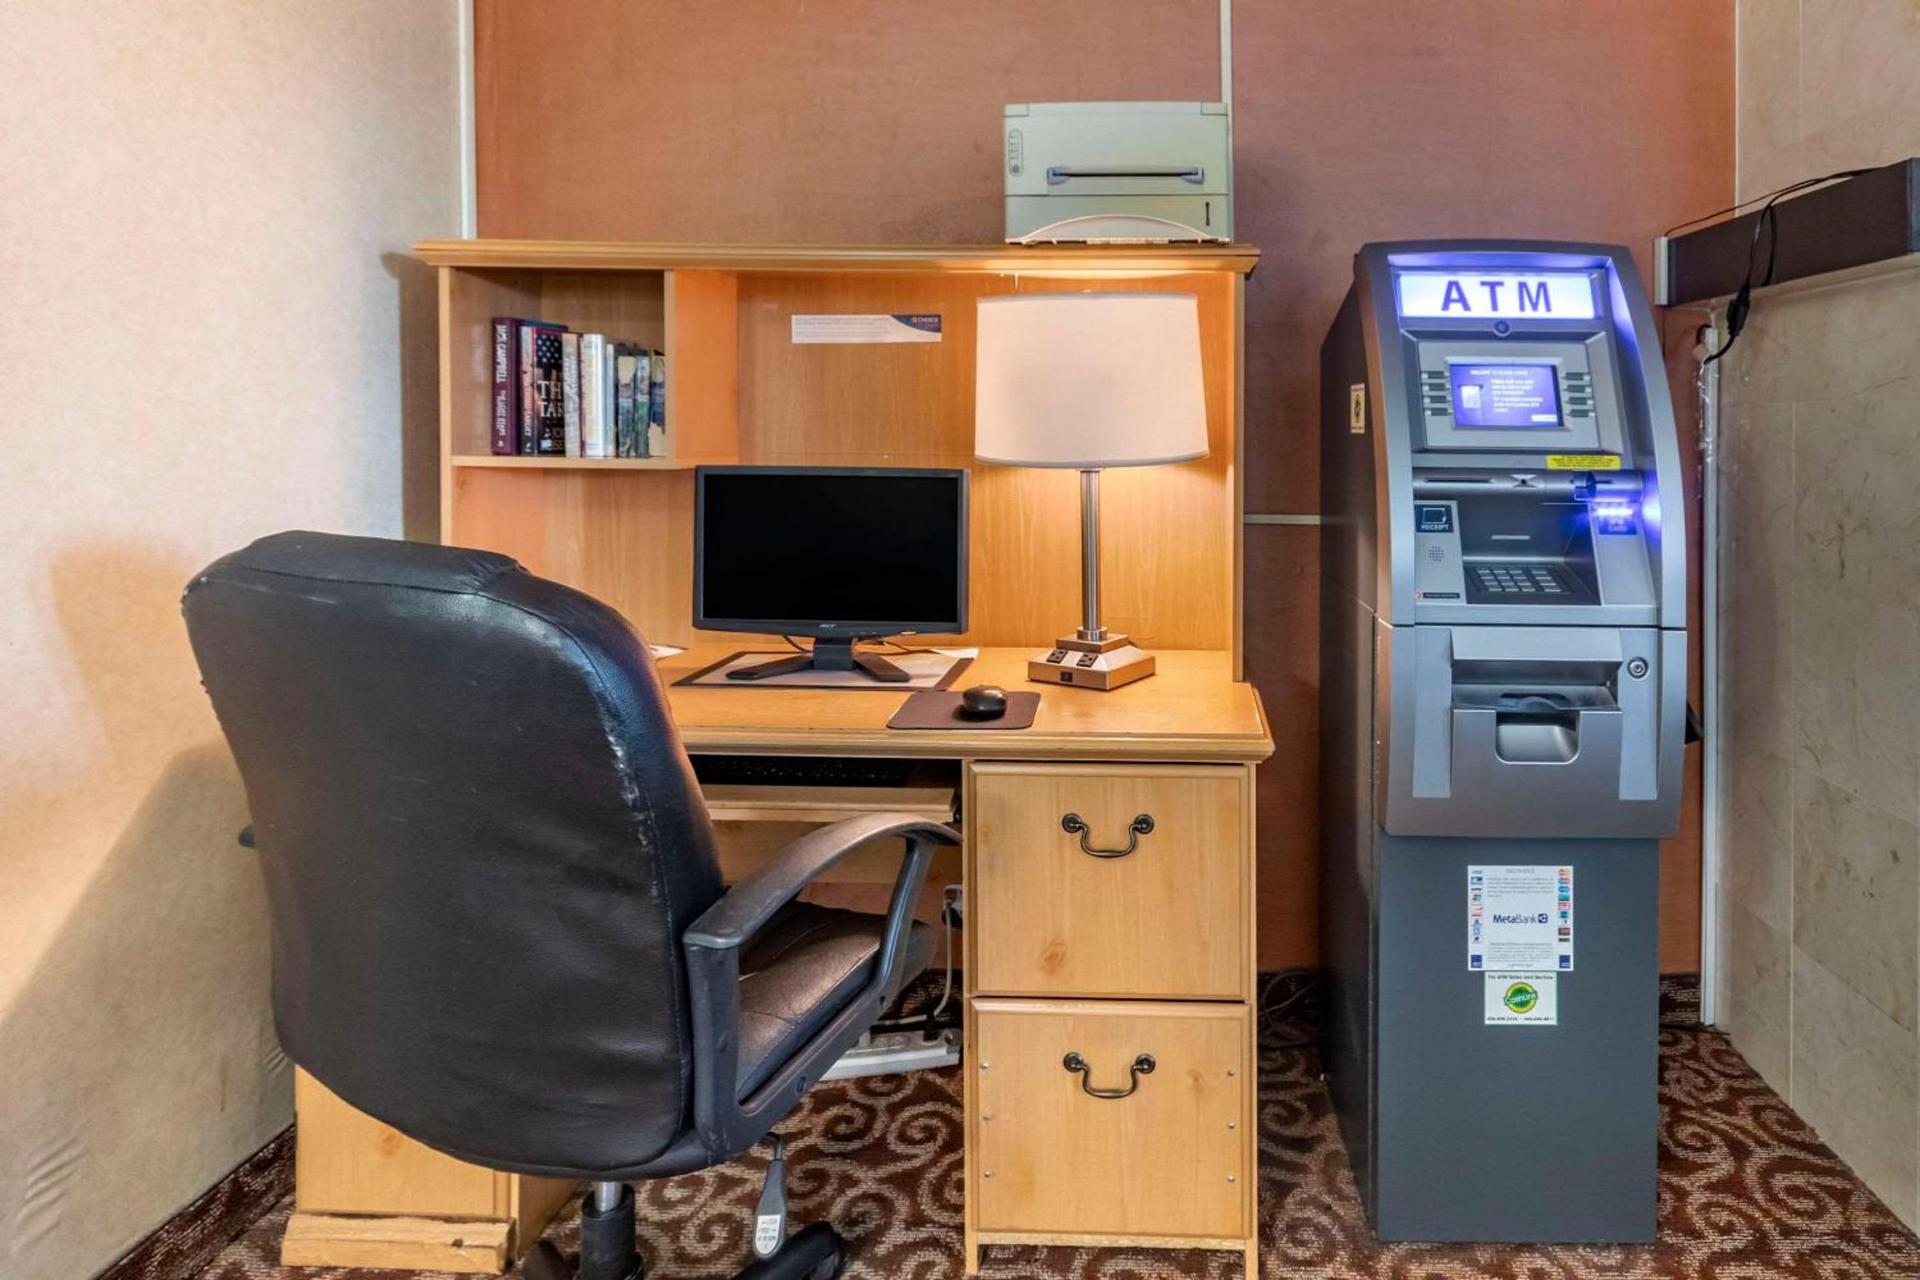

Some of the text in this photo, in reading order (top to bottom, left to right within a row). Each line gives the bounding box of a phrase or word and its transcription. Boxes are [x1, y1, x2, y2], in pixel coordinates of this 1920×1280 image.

[1441, 279, 1552, 312] ATM
[537, 380, 562, 399] TH
[1493, 913, 1537, 924] MetaBank
